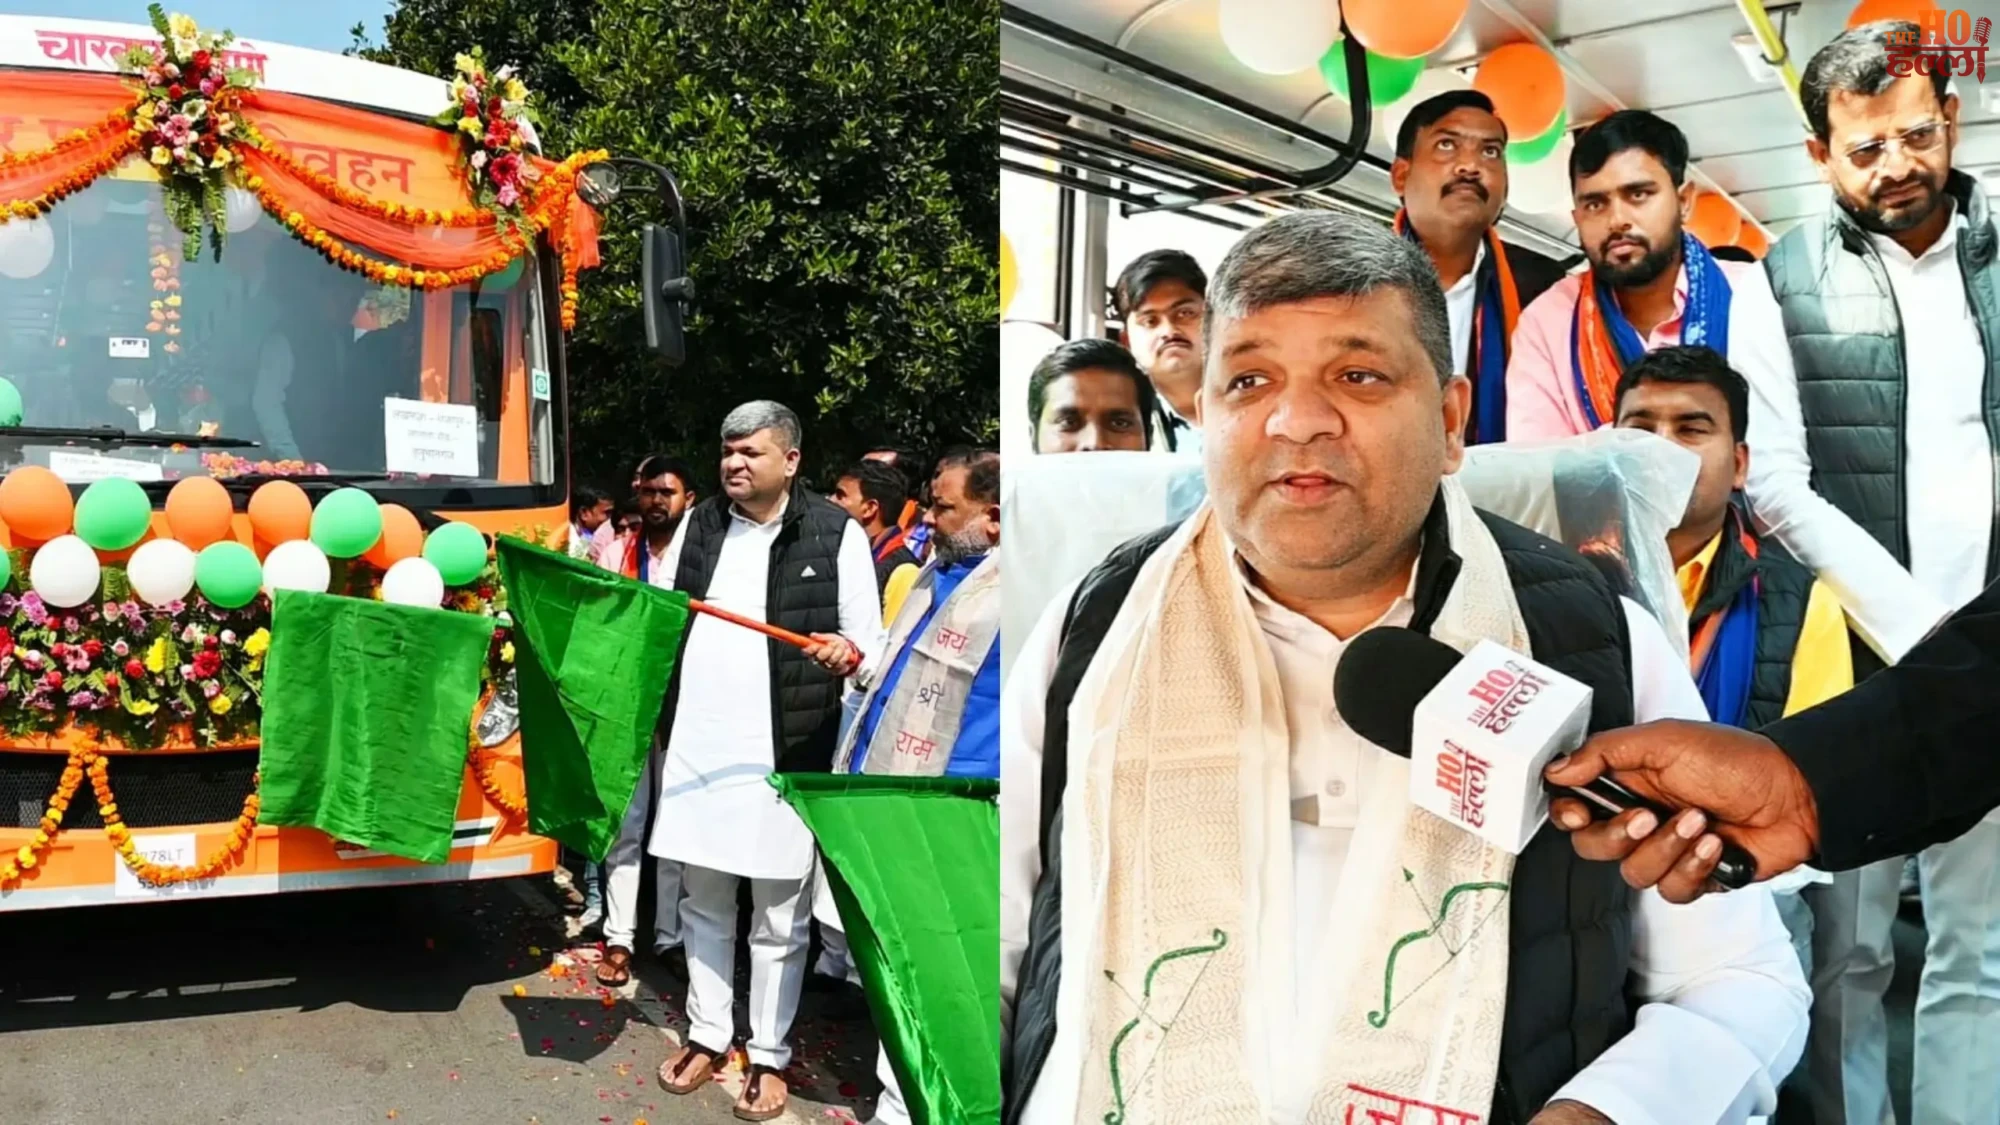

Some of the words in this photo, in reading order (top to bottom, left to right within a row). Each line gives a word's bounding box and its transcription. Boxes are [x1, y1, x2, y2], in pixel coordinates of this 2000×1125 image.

[936, 627, 968, 654] जय
[918, 682, 946, 711] श्री
[1469, 669, 1516, 706] HO
[1467, 704, 1490, 724] THE
[896, 730, 936, 762] राम
[1436, 752, 1463, 797] HO
[1450, 797, 1462, 819] THE
